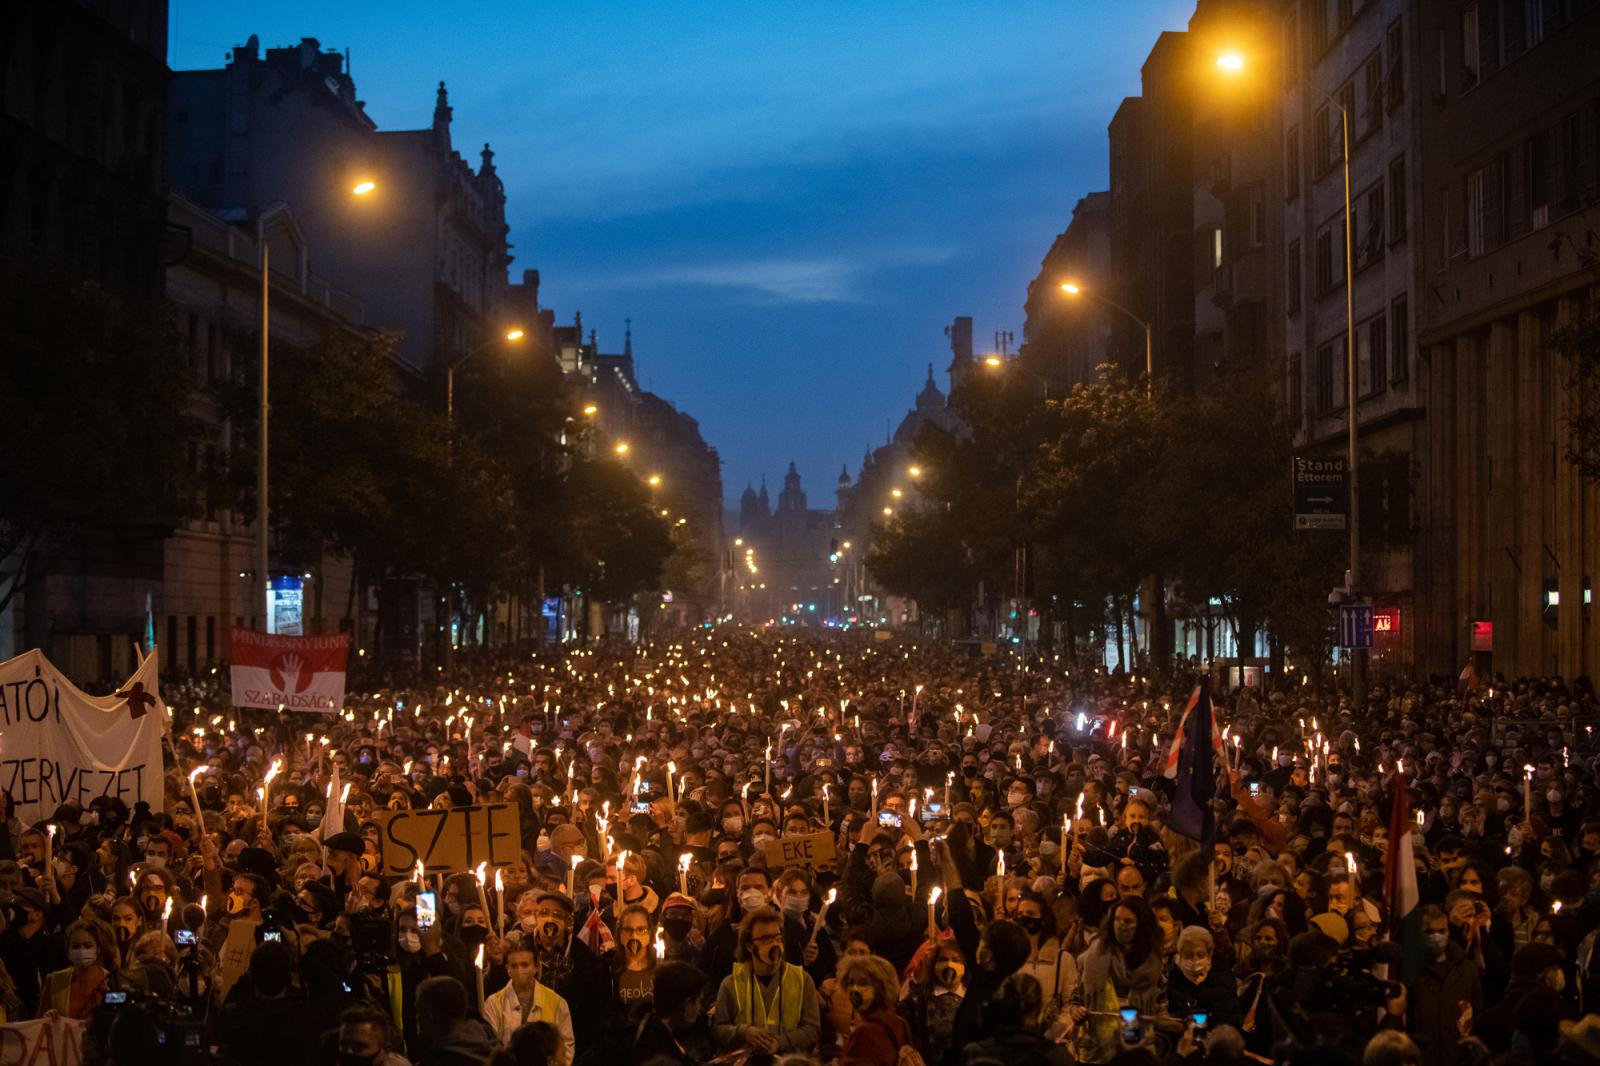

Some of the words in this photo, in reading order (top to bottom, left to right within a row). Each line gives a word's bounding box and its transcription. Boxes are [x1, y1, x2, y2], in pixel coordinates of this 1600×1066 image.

[1297, 459, 1343, 471] Stand
[244, 689, 337, 709] SZABADSÁGA
[0, 758, 146, 812] ZERVEZET
[387, 804, 514, 873] SZTE
[782, 839, 813, 861] EKE
